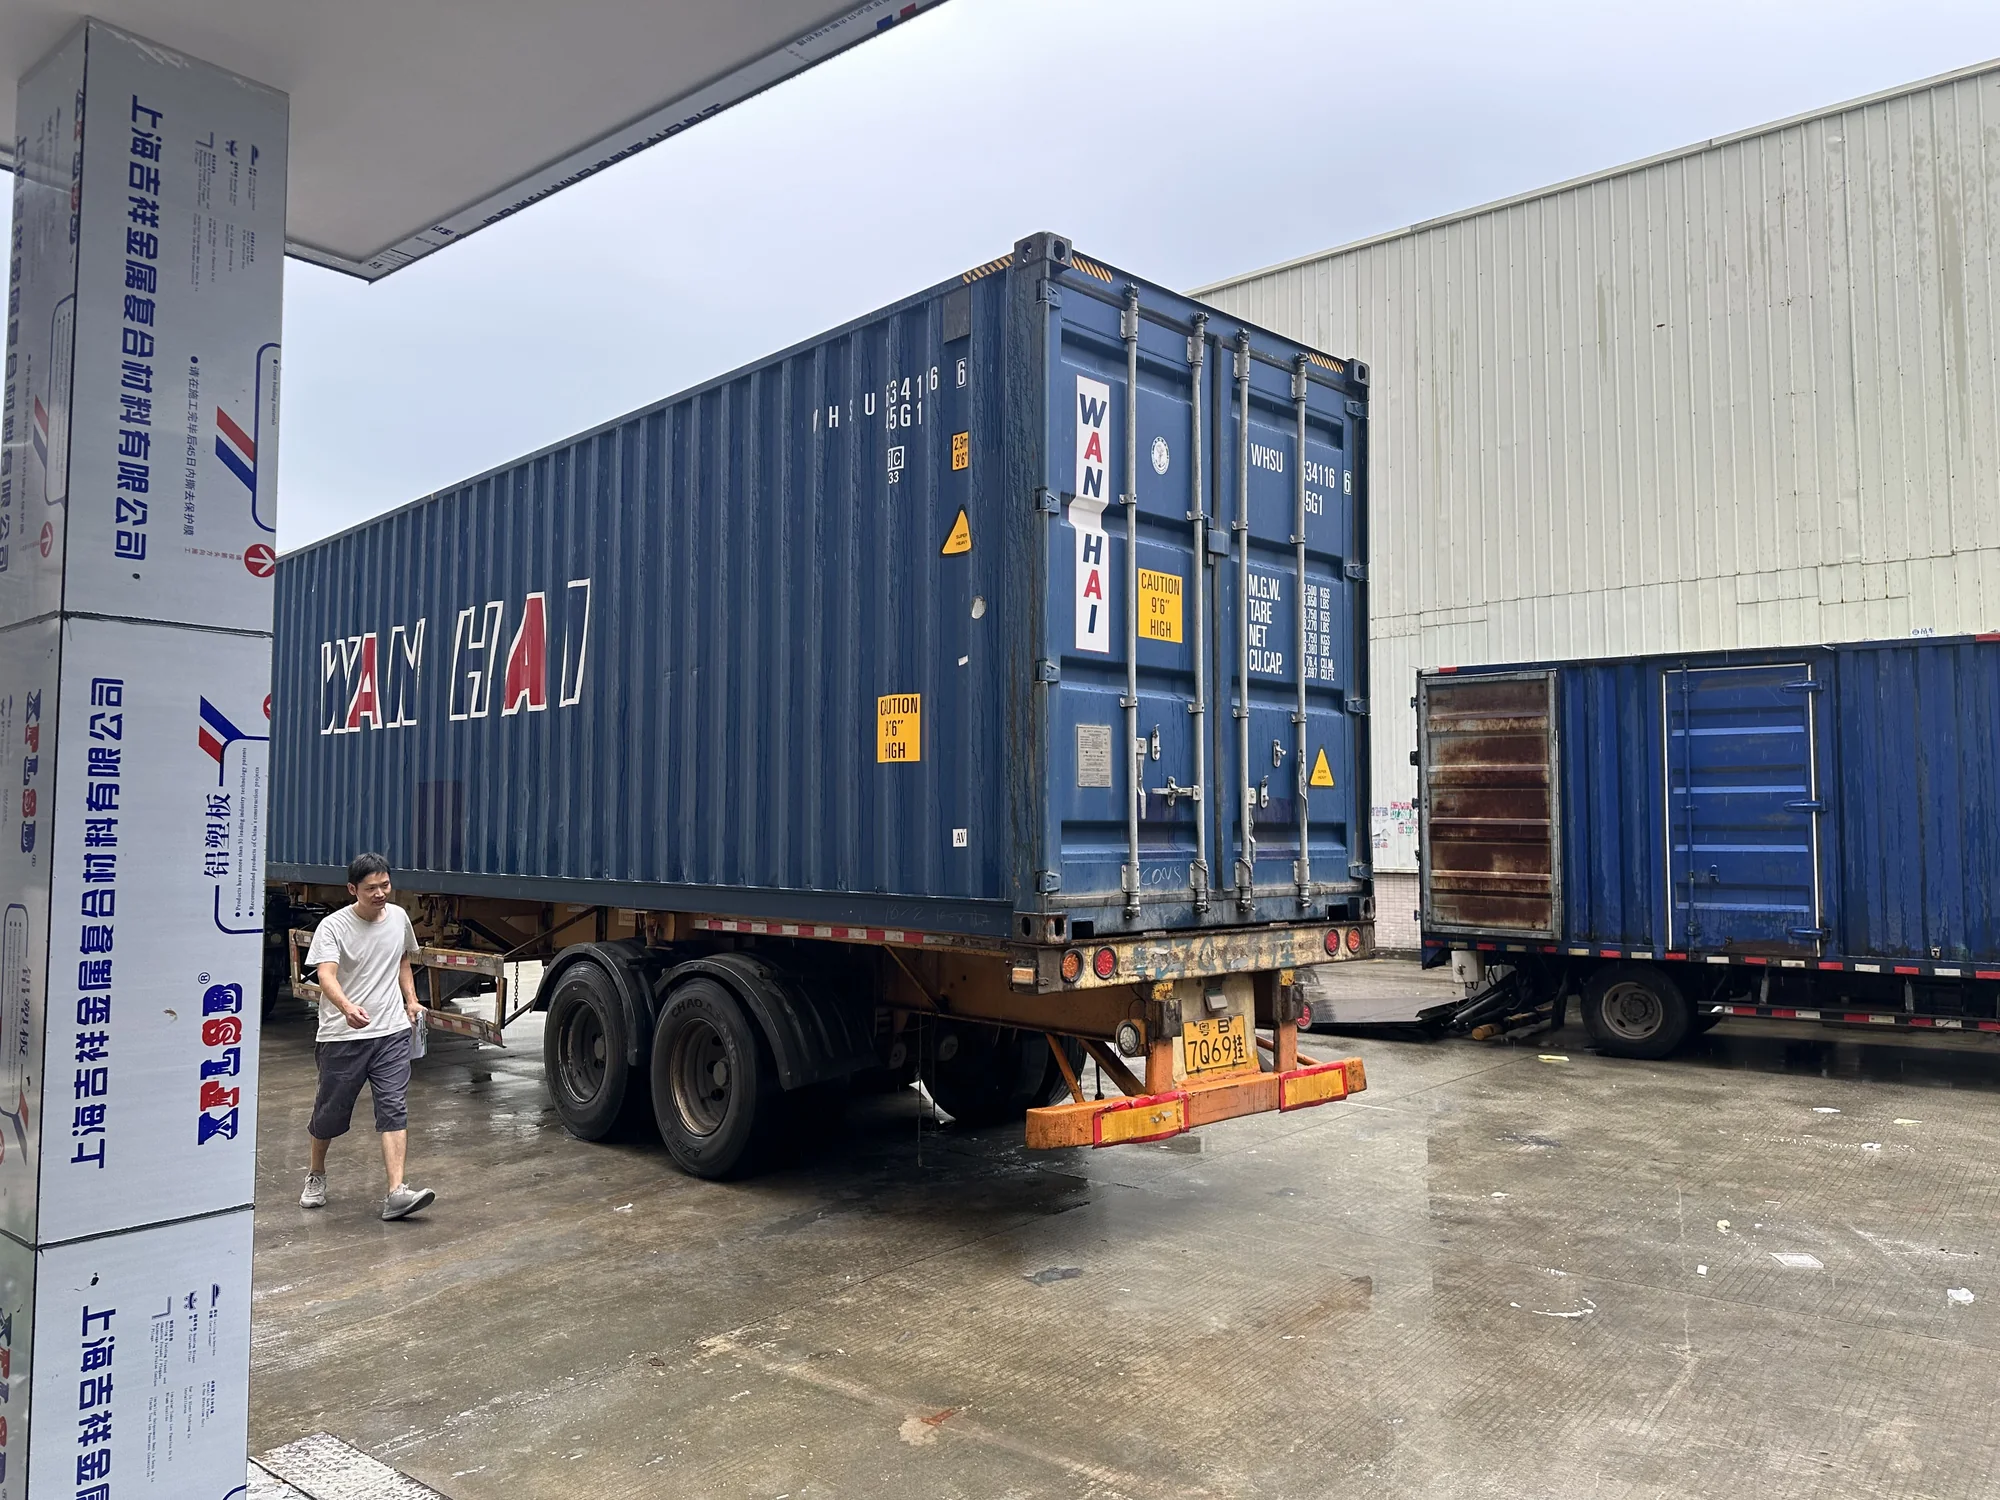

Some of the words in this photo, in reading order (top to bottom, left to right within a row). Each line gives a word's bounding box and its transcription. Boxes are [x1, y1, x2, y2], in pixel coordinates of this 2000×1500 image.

[114, 93, 164, 563] 上海吉祥金属复合材料有限公司
[958, 361, 965, 386] 6
[183, 366, 201, 536] 请在施工完毕后45日内撕去保护膜
[1080, 393, 1107, 498] WAN
[1251, 442, 1283, 473] WHSU
[888, 471, 899, 484] 33
[1344, 471, 1351, 494] 6
[1304, 490, 1323, 516] 5G1
[1083, 534, 1102, 633] HAI
[1141, 572, 1180, 596] CAUTION
[1248, 574, 1280, 601] M.G.W.
[1320, 587, 1330, 599] KGS
[1249, 598, 1272, 624] TARE
[1320, 611, 1330, 623] KGS
[1150, 617, 1171, 639] HIGH
[1249, 623, 1267, 648] NET
[1320, 634, 1330, 646] KGS
[320, 617, 426, 735] WAN
[449, 577, 591, 721] HAI
[1249, 649, 1282, 674] CU.CAP.
[239, 767, 247, 795] technology
[238, 796, 246, 818] industry
[204, 793, 231, 880] 铝塑板
[250, 849, 258, 871] products
[249, 872, 257, 910] Recommended
[70, 676, 125, 1169] 上海吉祥金属复合材料有限公司
[1188, 1034, 1244, 1067] 7Q69挂
